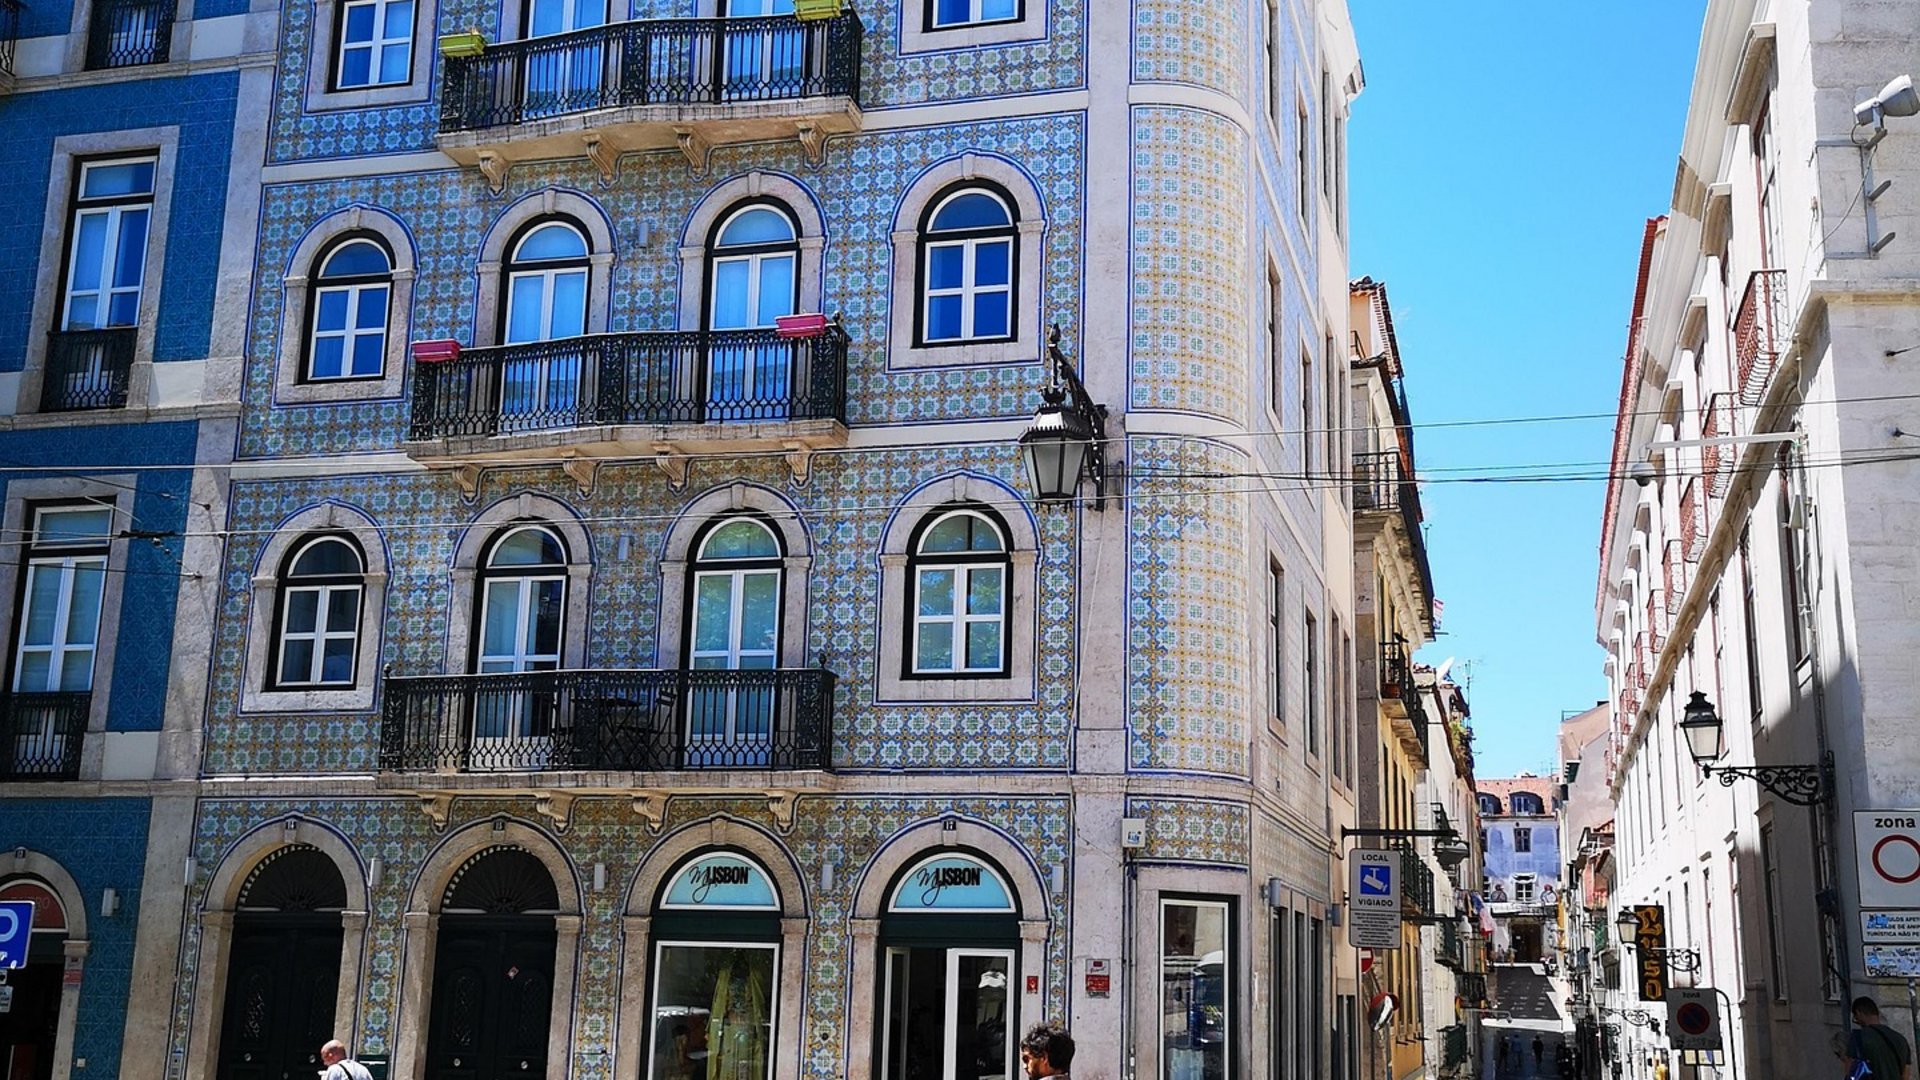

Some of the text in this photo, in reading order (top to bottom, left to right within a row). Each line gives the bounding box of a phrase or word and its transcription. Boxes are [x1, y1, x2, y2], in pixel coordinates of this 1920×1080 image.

[945, 821, 955, 830] 17
[1874, 818, 1916, 828] zona
[1361, 854, 1389, 862] LOCAL
[1358, 898, 1394, 907] VIGIADO
